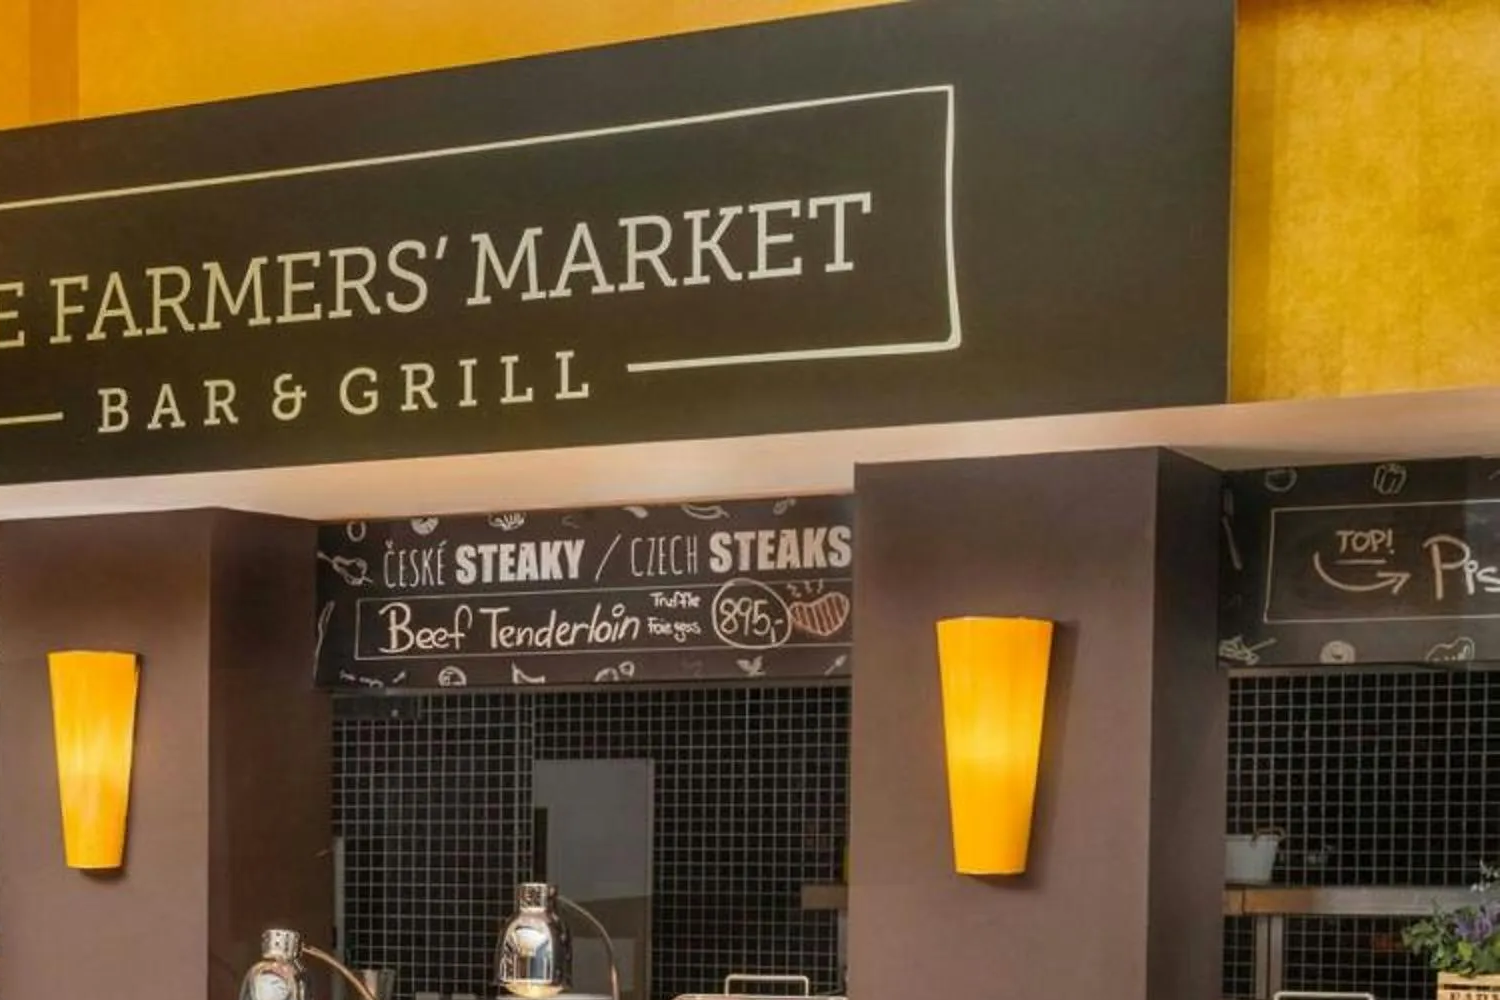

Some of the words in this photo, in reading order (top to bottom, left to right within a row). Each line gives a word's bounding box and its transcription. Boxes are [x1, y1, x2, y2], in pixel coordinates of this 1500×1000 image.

[49, 236, 448, 344] FARMERS'
[467, 191, 872, 306] MARKET
[97, 378, 239, 433] BAR
[270, 372, 308, 421] &
[338, 350, 590, 415] GRILL
[383, 539, 448, 588] ČESKÉ
[455, 538, 586, 585] STEAKY
[630, 534, 699, 578] CZECH
[708, 525, 852, 574] STEAKS
[1335, 528, 1395, 554] TOP!
[378, 601, 473, 654] Beef
[478, 601, 640, 649] Tenderloin
[649, 591, 701, 609] Truffle
